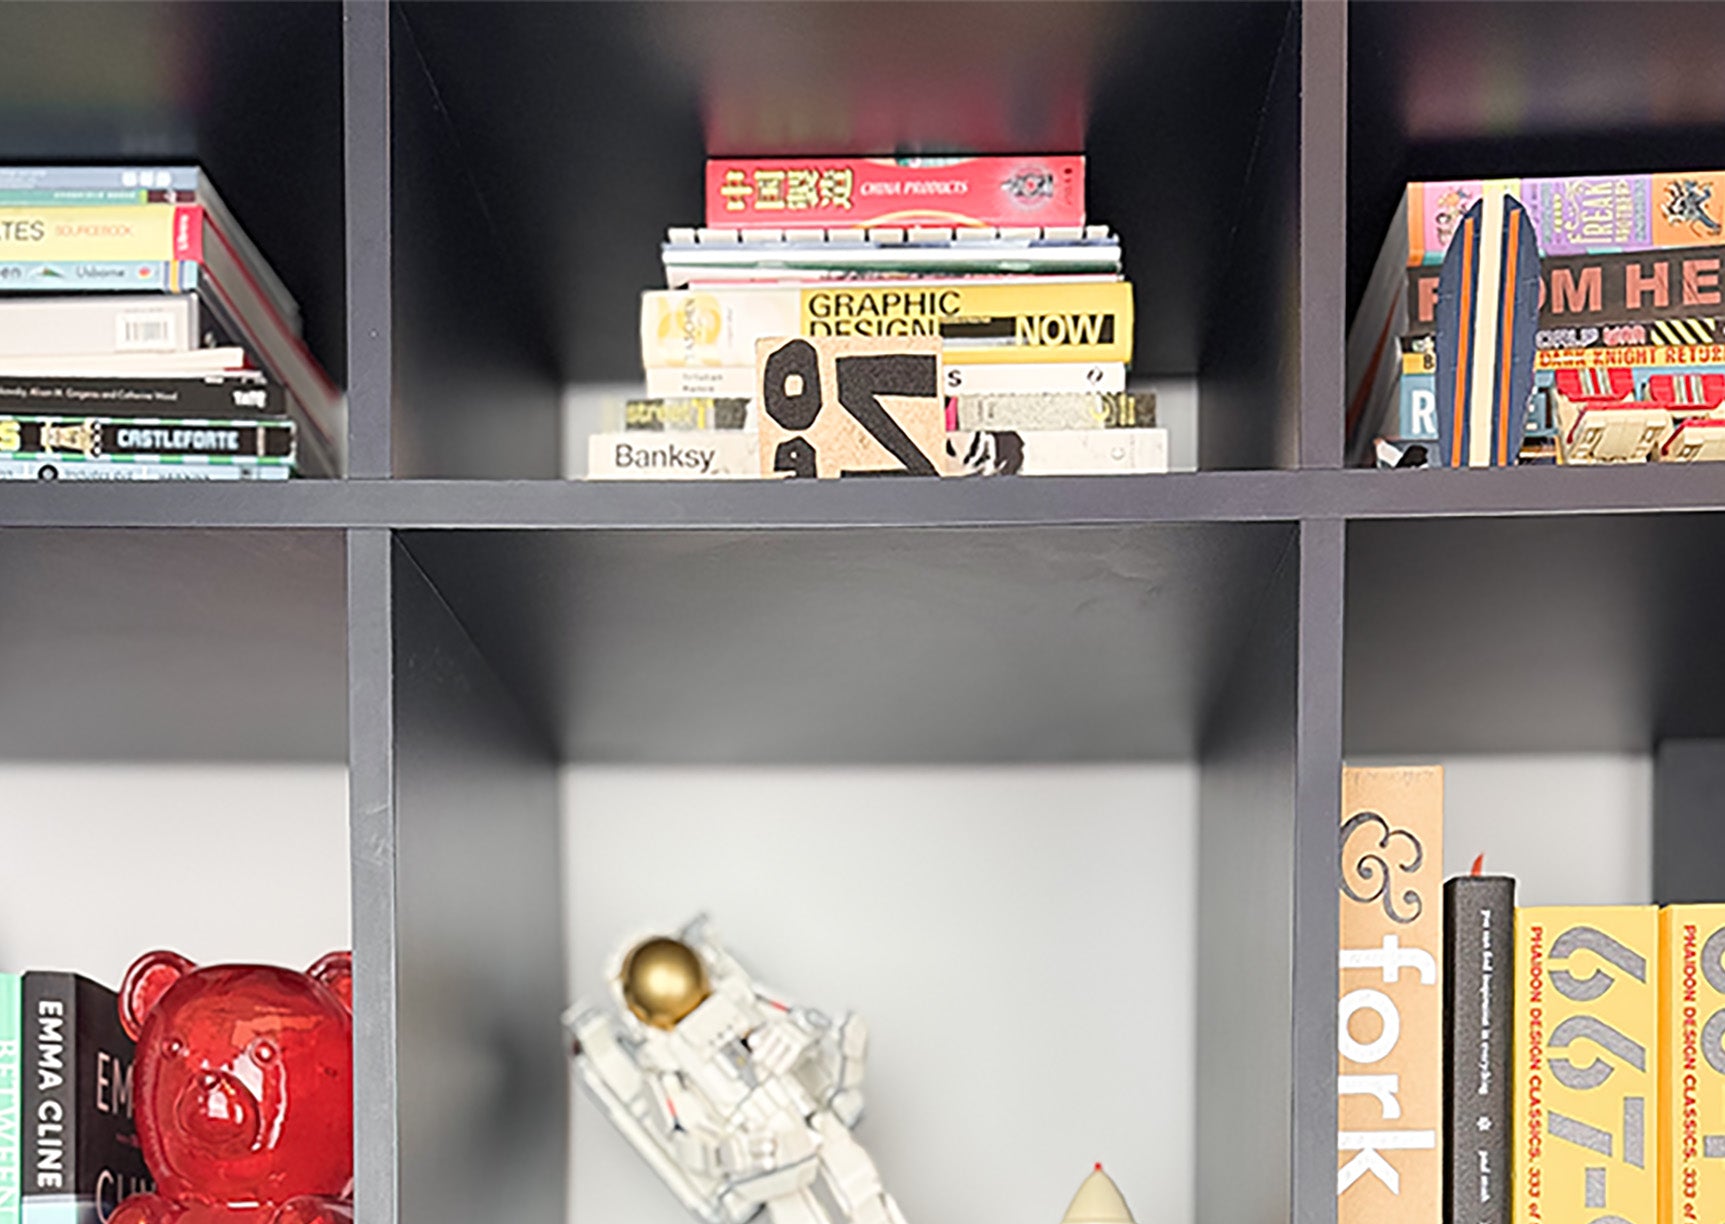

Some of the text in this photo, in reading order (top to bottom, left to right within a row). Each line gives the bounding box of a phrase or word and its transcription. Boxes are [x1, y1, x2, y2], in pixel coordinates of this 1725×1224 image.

[860, 180, 969, 196] CHINA PRODUCTS
[0, 220, 133, 242] TES SOURCEBOOK
[809, 291, 961, 318] GRAPHIC
[810, 314, 1104, 346] DESIGN NOW
[1593, 346, 1656, 365] KNIGHT
[117, 428, 240, 450] CASTLEFORTE
[614, 443, 716, 474] Banksy
[1530, 926, 1542, 1003] PHAIDON
[1683, 925, 1696, 1002] PHAIDON
[1530, 1008, 1542, 1071] DESIGN
[1683, 1007, 1696, 1070] DESIGN
[1338, 933, 1437, 1197] fork
[38, 1000, 63, 1188] EMMA CLINE
[1529, 1168, 1541, 1198] 333
[1683, 1167, 1696, 1197] 333
[1529, 1202, 1541, 1220] of
[1683, 1203, 1696, 1220] of
